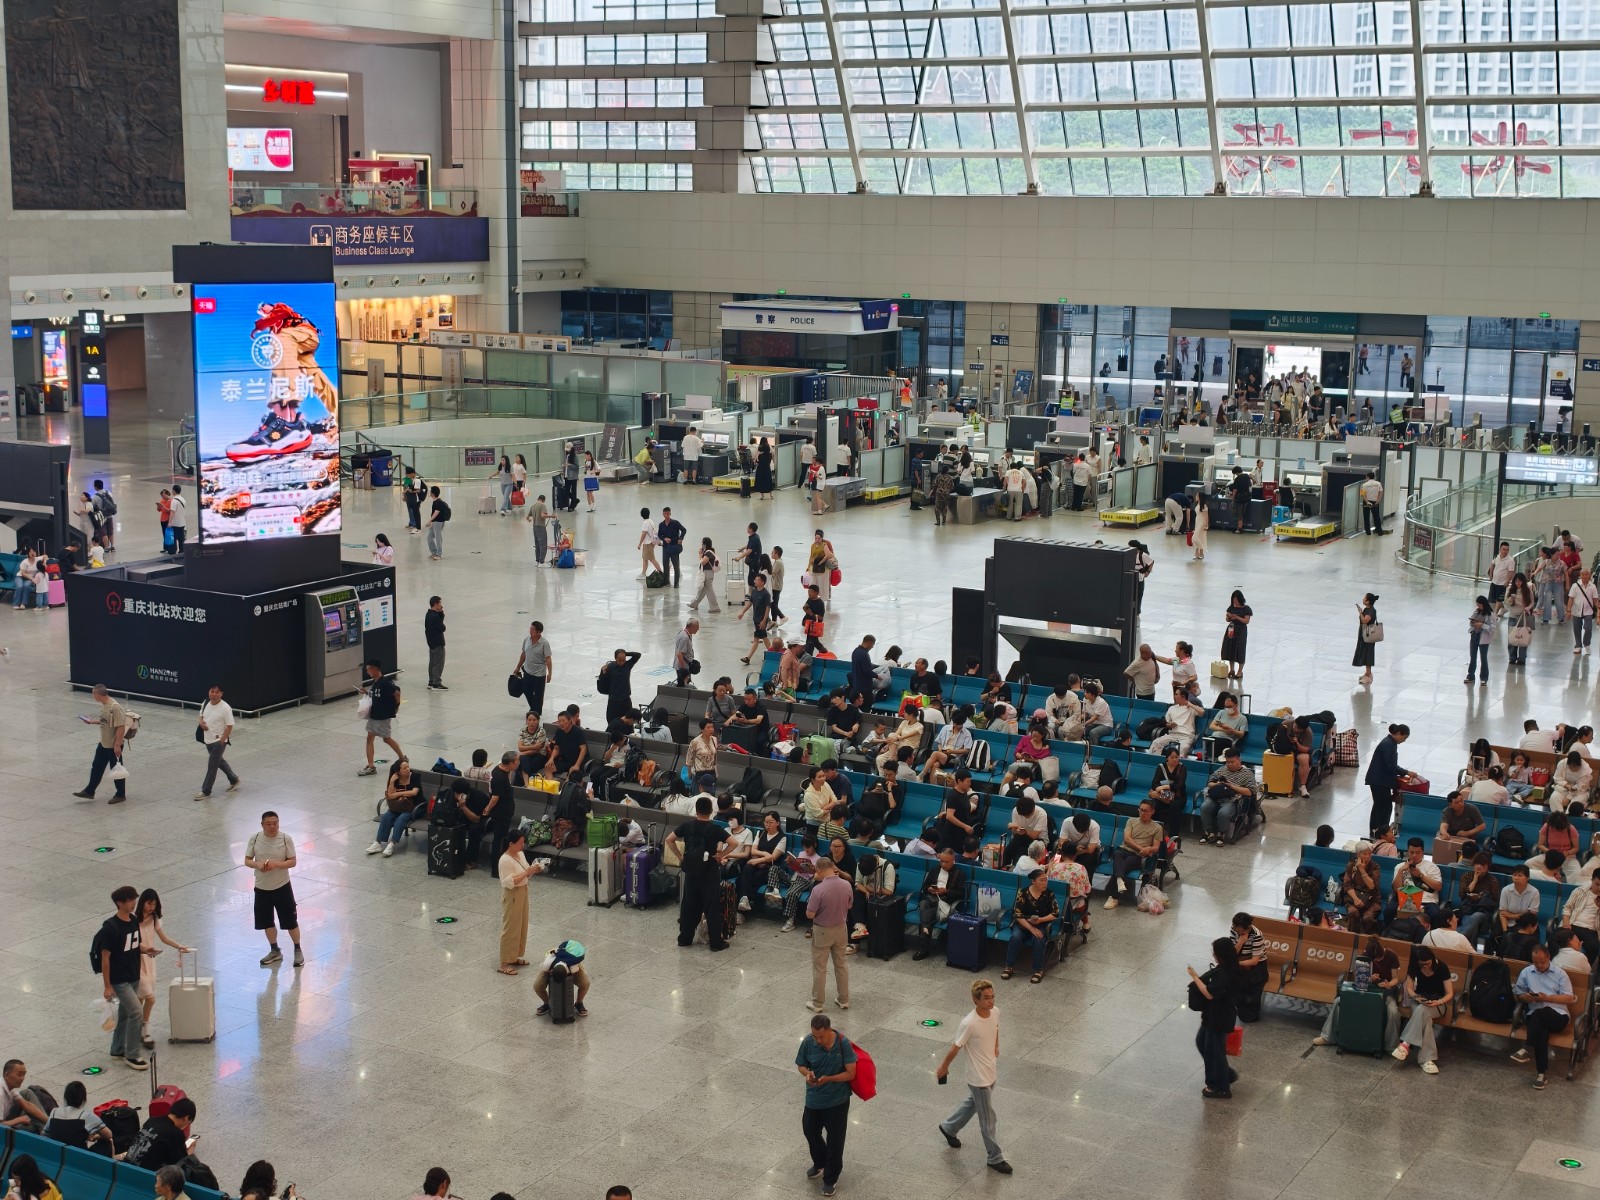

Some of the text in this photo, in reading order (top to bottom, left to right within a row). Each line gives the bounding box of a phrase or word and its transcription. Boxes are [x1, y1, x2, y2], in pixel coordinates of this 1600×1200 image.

[335, 225, 415, 245] 商务座候车区
[335, 245, 415, 257] Business Class Lounge
[755, 313, 776, 324] 警察
[790, 316, 815, 325] POLICE
[86, 346, 99, 355] 1A
[220, 376, 316, 403] 泰兰尼斯
[123, 598, 207, 624] 重庆北站欢迎您
